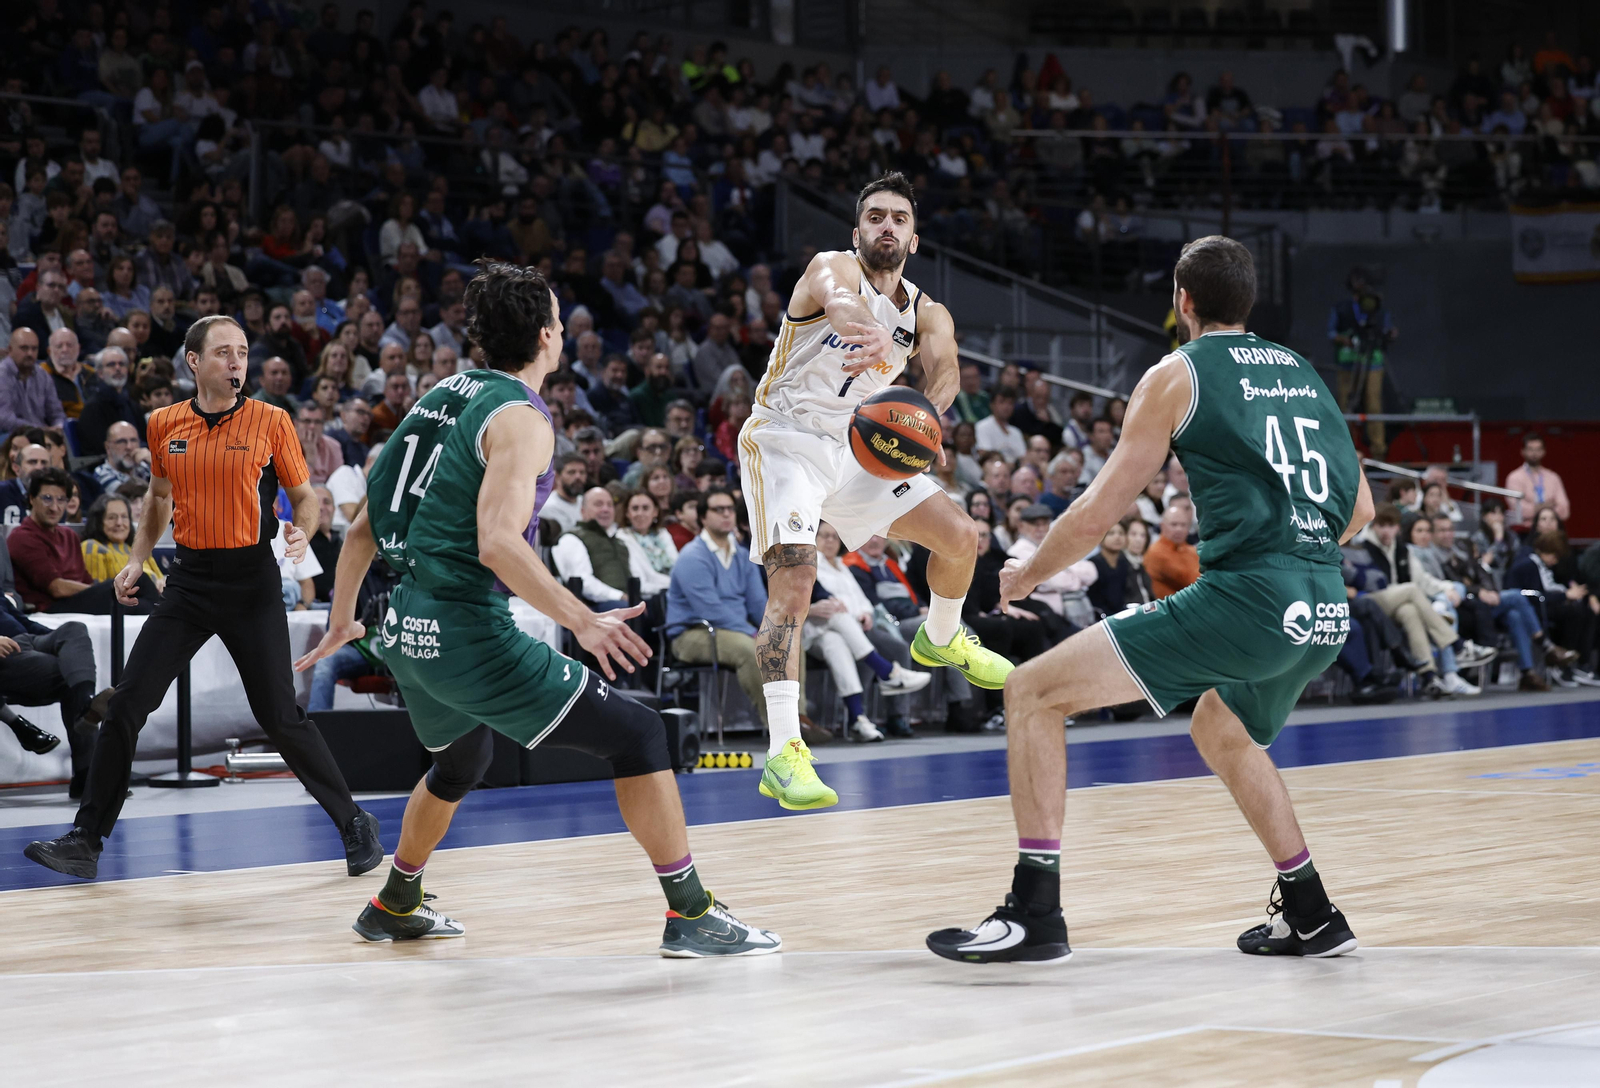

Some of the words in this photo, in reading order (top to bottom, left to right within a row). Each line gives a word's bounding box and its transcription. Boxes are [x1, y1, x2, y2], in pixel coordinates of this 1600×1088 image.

[1228, 347, 1300, 368] KRAVISH
[886, 408, 940, 446] SPALDING
[870, 432, 892, 455] liga
[1265, 415, 1329, 504] 45
[390, 433, 443, 513] 14
[895, 486, 908, 497] acb
[1315, 603, 1350, 618] COST
[402, 615, 440, 633] COSTA
[1314, 619, 1338, 633] DEL
[1339, 619, 1351, 632] SO
[401, 631, 417, 646] DEL
[418, 635, 441, 647] SOL
[1311, 632, 1348, 646] MÁLAG
[401, 644, 440, 659] MÁLAGA
